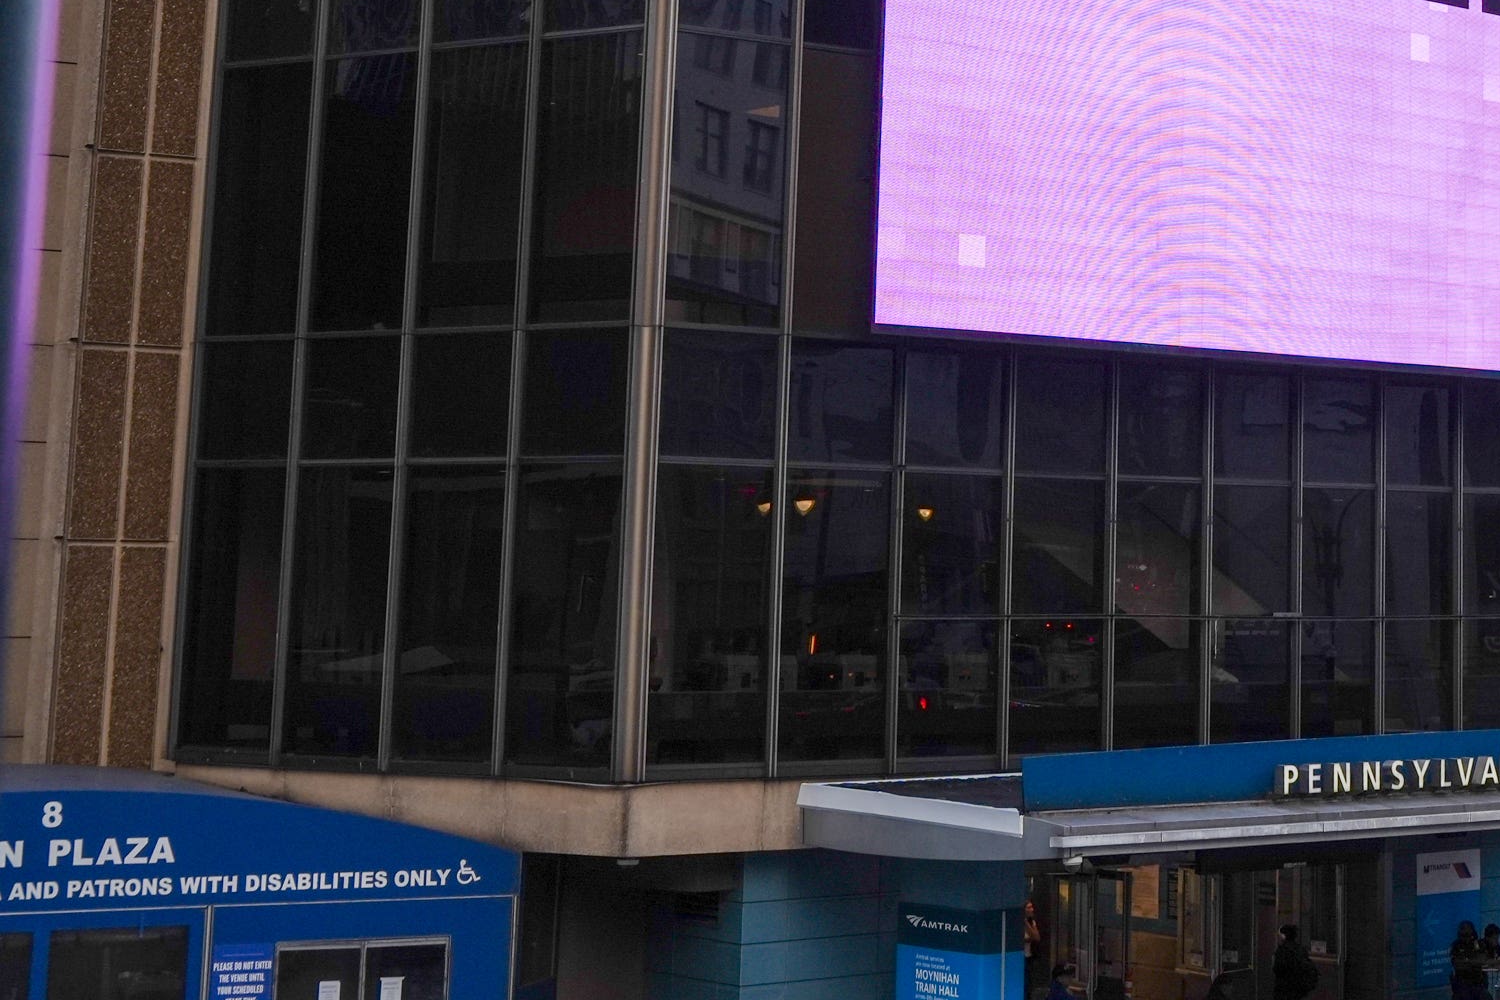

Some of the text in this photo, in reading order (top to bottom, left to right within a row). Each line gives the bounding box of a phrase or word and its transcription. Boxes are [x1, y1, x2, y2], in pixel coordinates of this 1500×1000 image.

[42, 801, 63, 828] 8
[48, 836, 175, 867] PLAZA
[8, 881, 60, 900] AND
[67, 876, 173, 899] PATRONS
[180, 875, 238, 895] WITH
[245, 871, 388, 892] DISABILITIES
[394, 868, 452, 888] ONLY
[921, 919, 968, 933] AMTRAK
[213, 960, 272, 972] PLEASE DO NOT ENTER
[219, 972, 264, 984] THE VENUE UNTIL
[915, 968, 960, 985] MOYNIHAN
[217, 984, 264, 996] YOUR SCHEDULED
[915, 981, 937, 995] TRAIN
[939, 985, 959, 998] HALL
